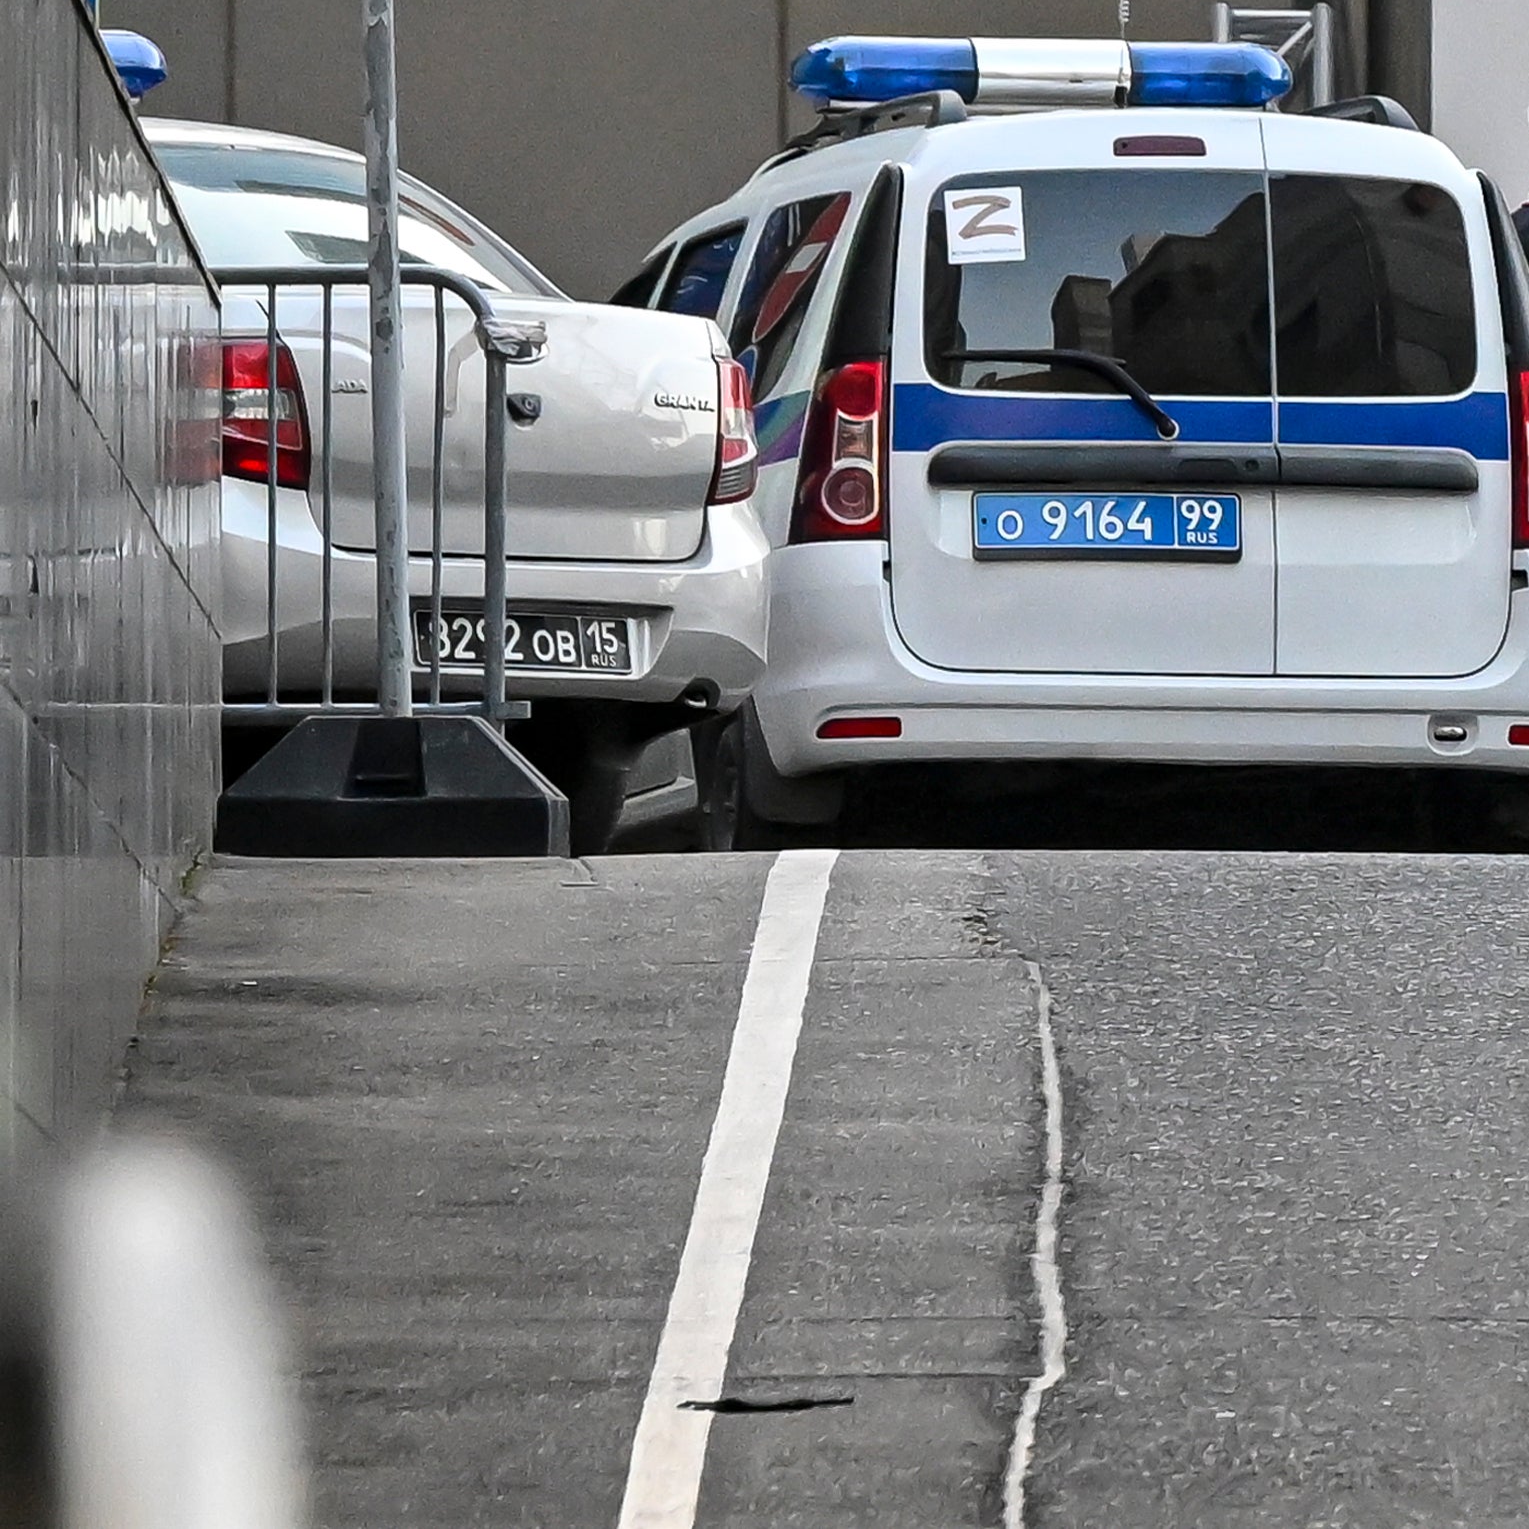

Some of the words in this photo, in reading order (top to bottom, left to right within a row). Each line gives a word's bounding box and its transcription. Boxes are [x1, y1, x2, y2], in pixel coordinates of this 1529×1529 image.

[952, 195, 1018, 239] Z
[654, 392, 715, 412] GRANTA
[1042, 500, 1153, 541] 9164
[1180, 499, 1223, 531] 99
[1187, 532, 1218, 544] RUS
[586, 620, 619, 654] 15
[591, 654, 617, 667] RUS
